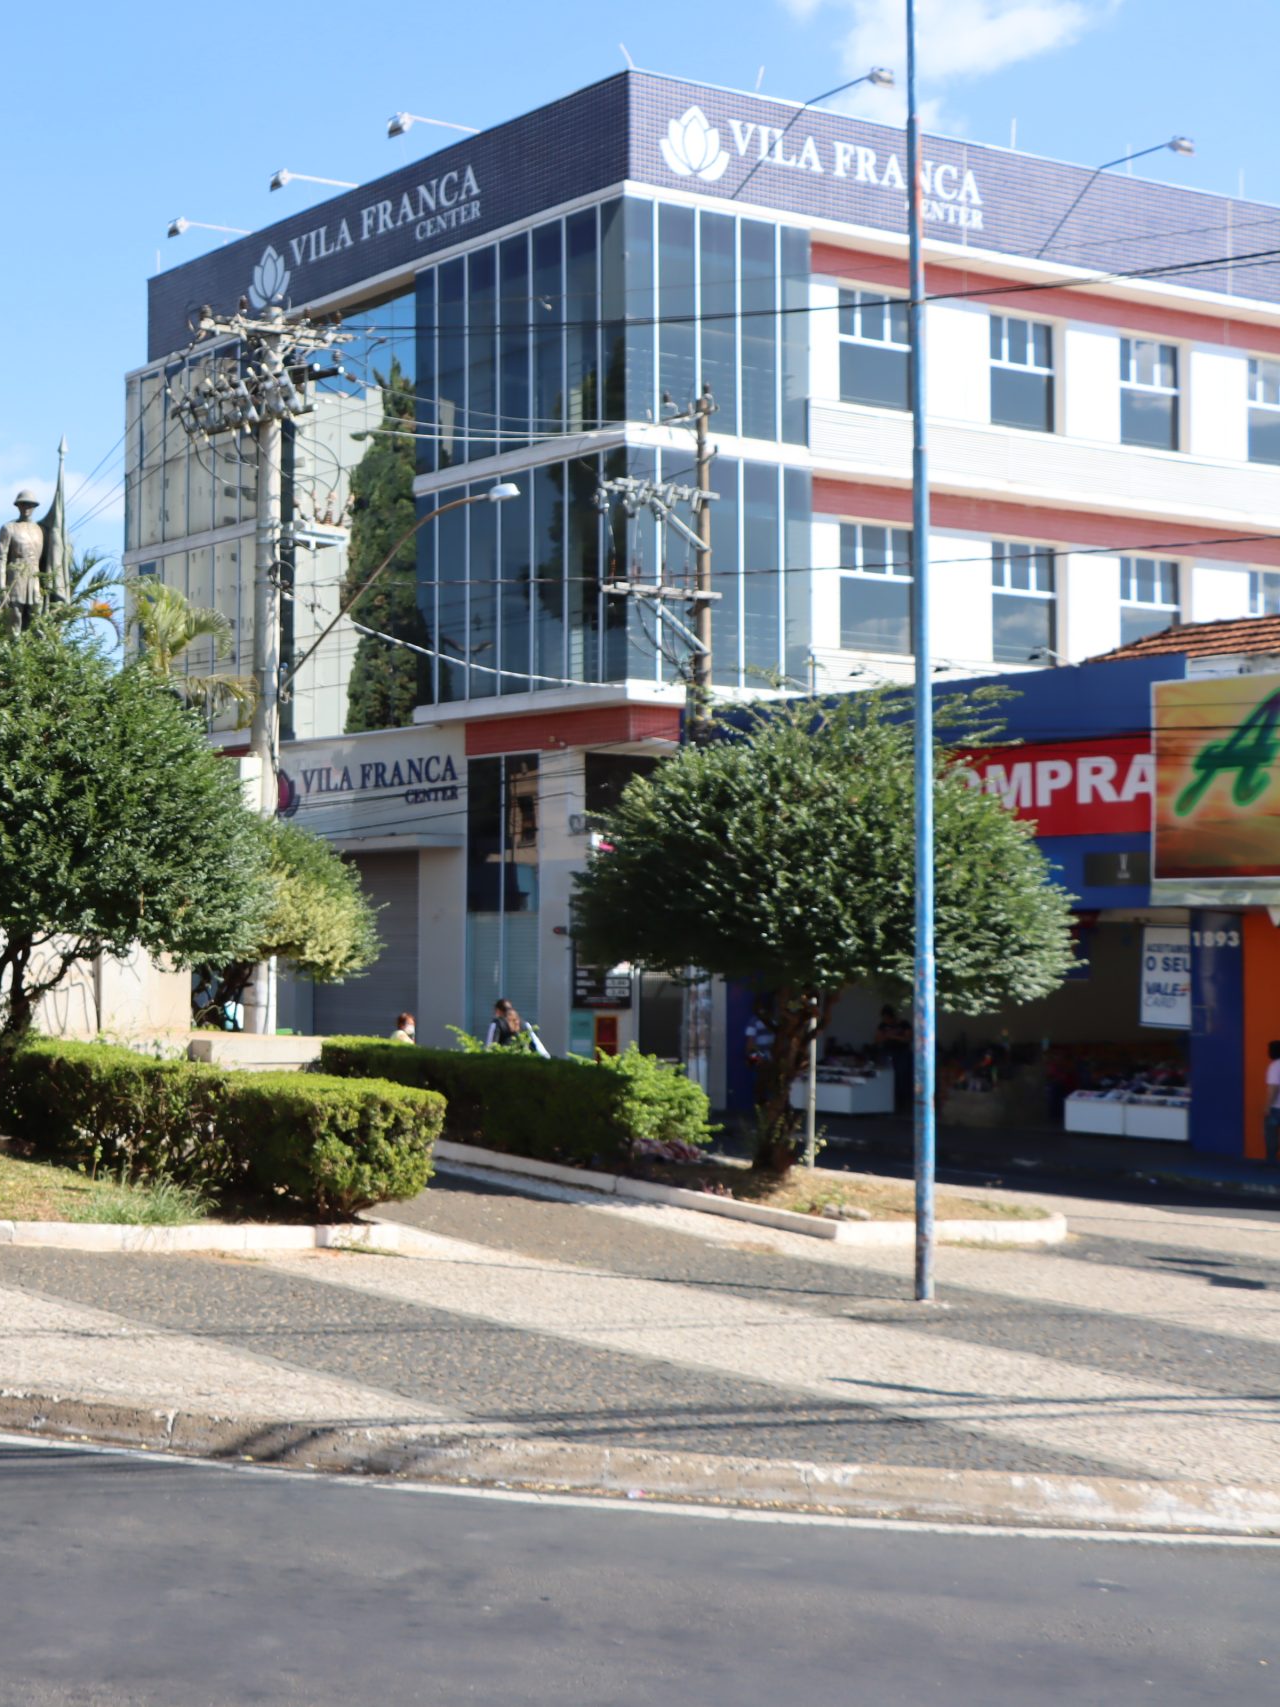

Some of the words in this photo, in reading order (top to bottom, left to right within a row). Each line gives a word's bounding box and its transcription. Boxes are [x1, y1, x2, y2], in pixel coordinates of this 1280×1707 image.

[727, 118, 824, 173] VILA
[833, 140, 984, 206] FRANCA
[289, 218, 354, 267] VILA
[360, 164, 481, 241] FRANCA
[415, 200, 481, 241] CENTER
[904, 198, 984, 230] ENTER
[301, 765, 353, 794] VILA
[360, 754, 459, 789] FRANCA
[405, 784, 459, 805] CENTER
[1192, 930, 1240, 948] 1893
[1145, 955, 1157, 972] O
